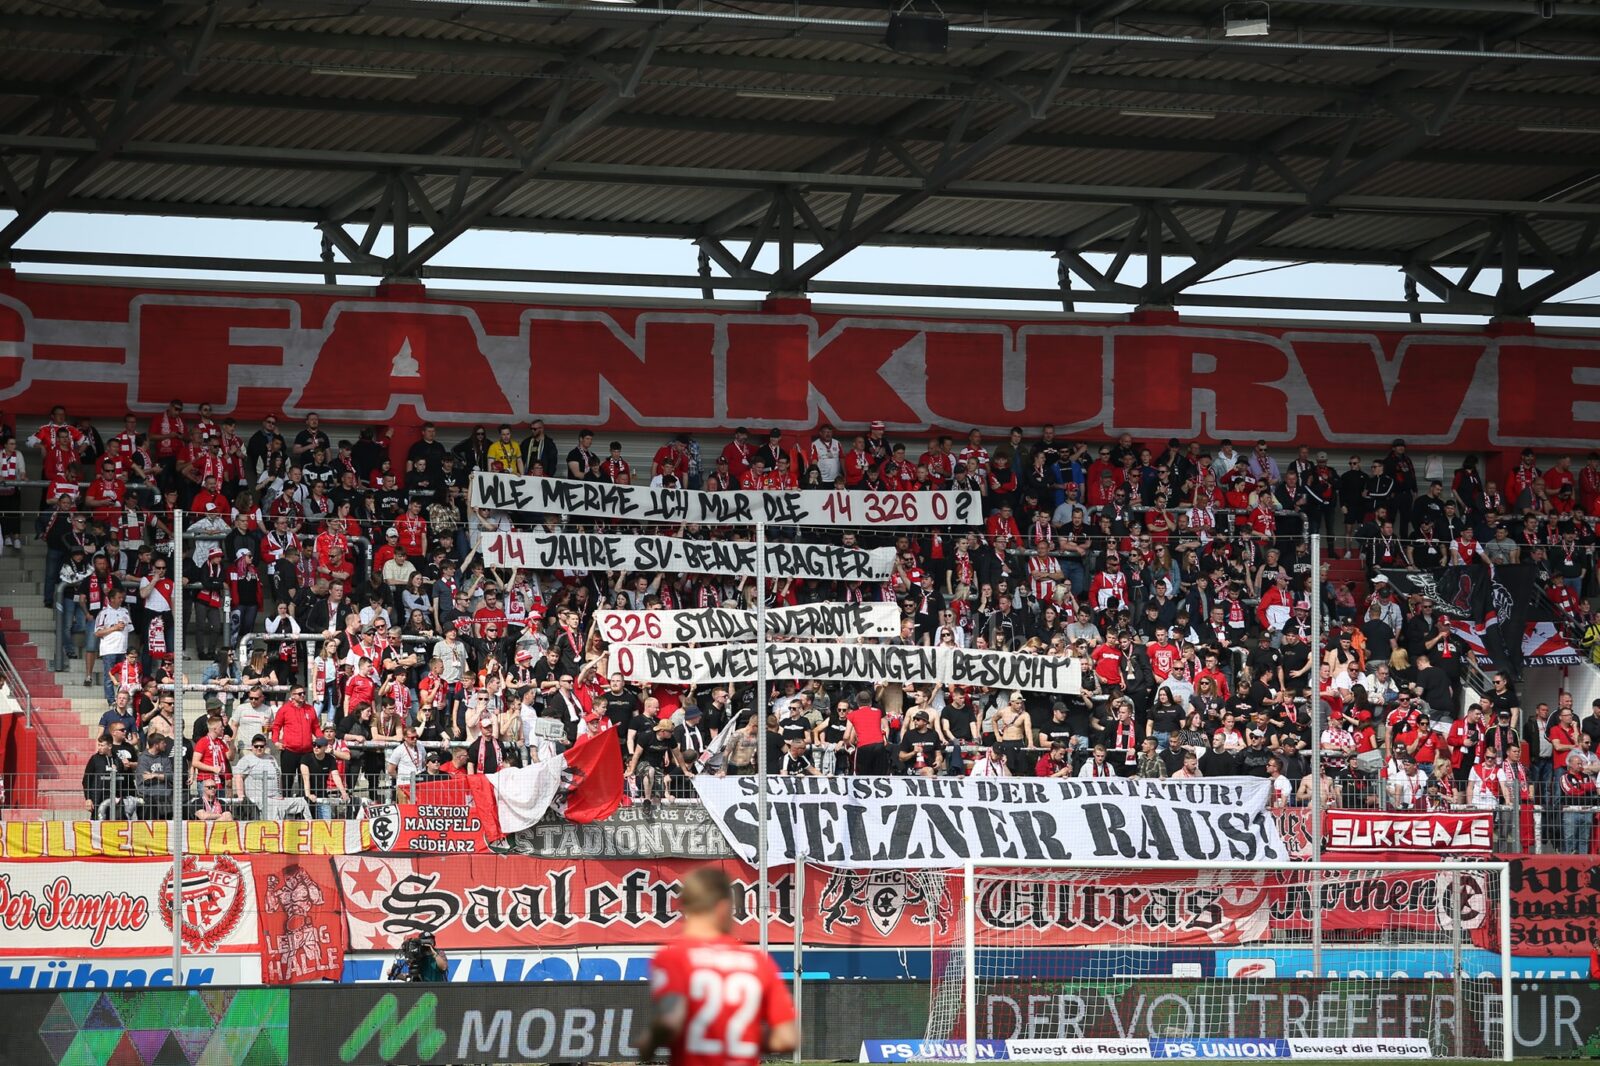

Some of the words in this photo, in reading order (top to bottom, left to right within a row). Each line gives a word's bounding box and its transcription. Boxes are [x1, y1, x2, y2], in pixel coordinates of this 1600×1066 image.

[478, 474, 533, 509] WIE
[541, 480, 639, 516] MERKE
[644, 488, 688, 519] ICH
[700, 492, 753, 521] MIR
[764, 492, 808, 522] DIE
[823, 492, 852, 523] 14
[864, 492, 917, 522] 326
[488, 534, 525, 564] 14
[535, 533, 625, 567] JAHRE
[604, 612, 662, 642] 326
[618, 647, 634, 677] 0
[952, 650, 1070, 689] BESUCHT
[738, 776, 852, 800] SCHLUSS
[902, 777, 965, 799] MIT
[977, 780, 1050, 803] DER
[1058, 780, 1243, 806] DIKTATUR!
[404, 817, 481, 832] MANSFELD
[418, 806, 470, 817] SEKTION
[0, 819, 169, 857] ULLEN
[409, 835, 475, 852] SÜDHARZ
[514, 822, 738, 857] STADIONVER
[723, 801, 1072, 864] STELZNER
[1081, 803, 1278, 861] RAUS!
[1332, 819, 1491, 847] SURREALE
[37, 876, 149, 948] Sempre
[381, 865, 797, 934] Saalefrnt
[268, 947, 340, 981] HALLE
[685, 969, 763, 1058] 22
[457, 1008, 672, 1059] MOBIL
[880, 1044, 914, 1058] PS
[920, 1043, 996, 1058] UNION
[1013, 1045, 1067, 1057] bewegt
[1071, 1045, 1093, 1055] die
[1098, 1044, 1148, 1057] Region
[1164, 1043, 1196, 1058] PS
[1201, 1042, 1276, 1058] UNION
[1293, 1044, 1348, 1056] bewegt
[1352, 1044, 1373, 1053] die
[1378, 1043, 1427, 1056] Region
